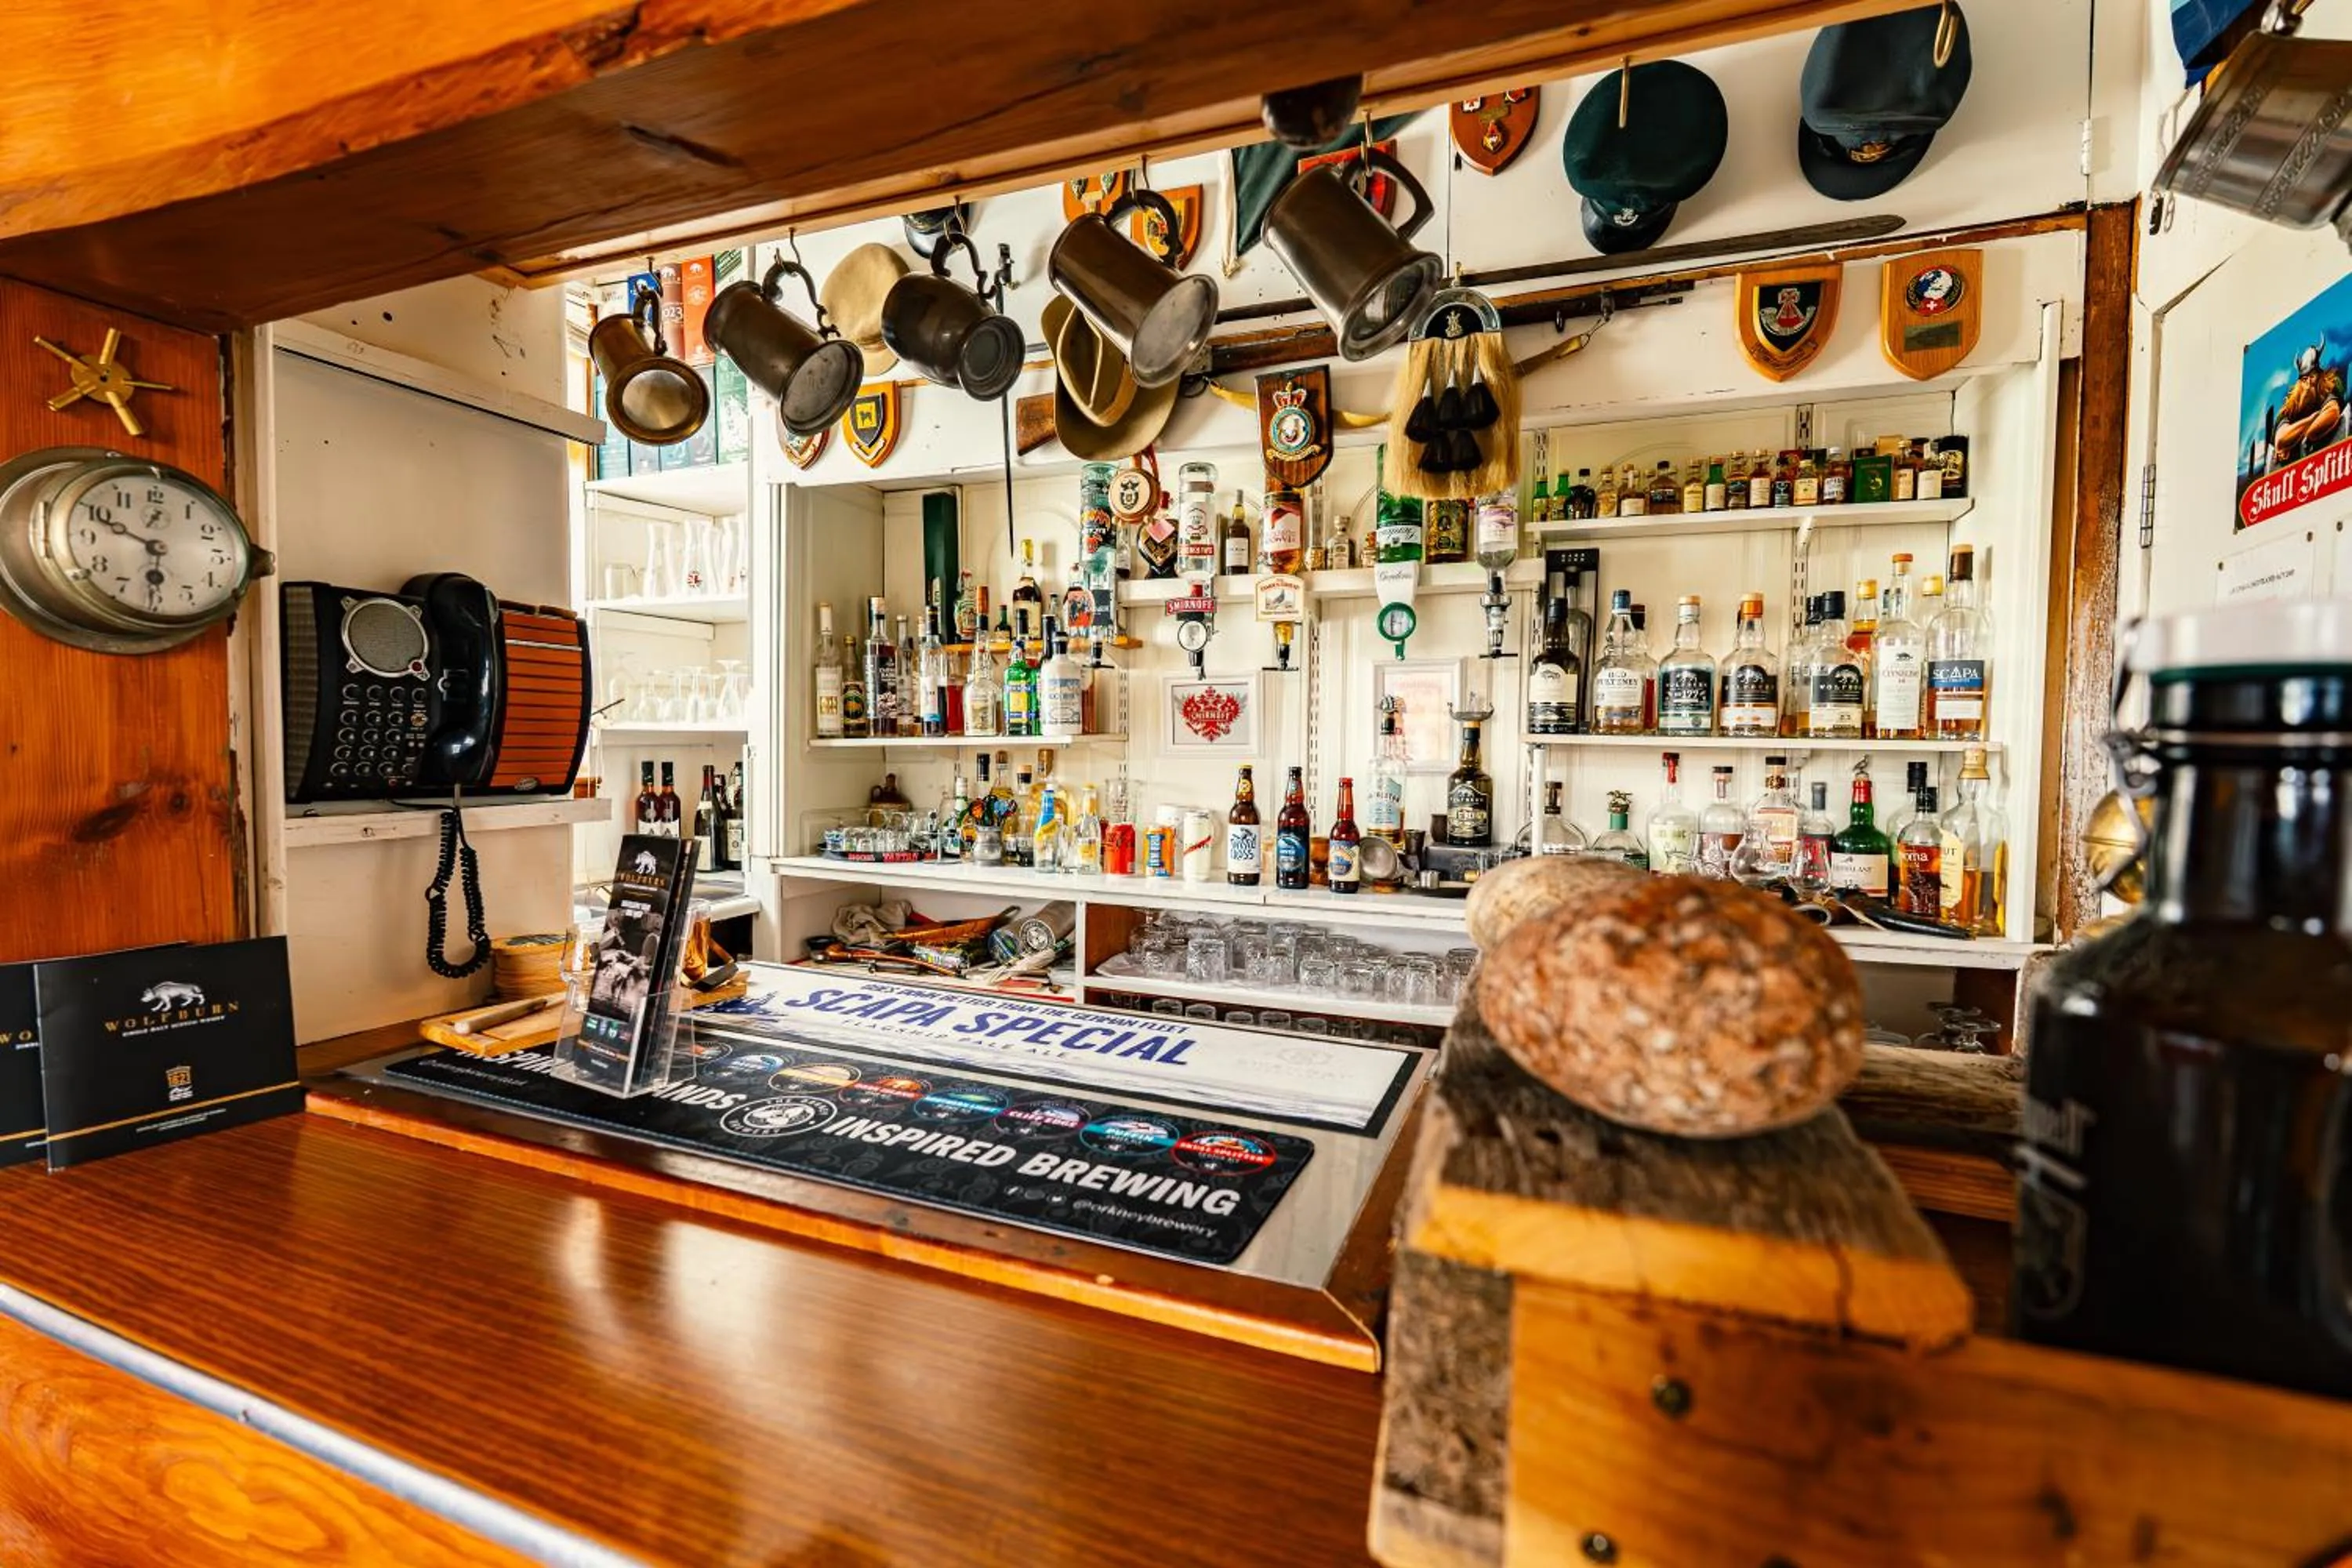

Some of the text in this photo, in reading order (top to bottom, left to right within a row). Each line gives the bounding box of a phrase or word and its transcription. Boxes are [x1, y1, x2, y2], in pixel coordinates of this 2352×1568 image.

[2248, 442, 2352, 522] Skull Splitt
[1168, 599, 1214, 613] SMIRNOFF
[1933, 666, 1978, 678] SCAPA
[105, 1000, 239, 1033] WOLFBURN
[784, 989, 1196, 1065] SCAPA SPECIAL
[996, 1001, 1041, 1014] THAN
[1040, 1007, 1068, 1019] THE
[1070, 1011, 1139, 1027] GERMAN
[1138, 1020, 1190, 1035] FLEET
[822, 1116, 1017, 1167] INSPIRED
[1018, 1152, 1241, 1216] BREWING
[1072, 1199, 1217, 1238] @orkneybrewery
